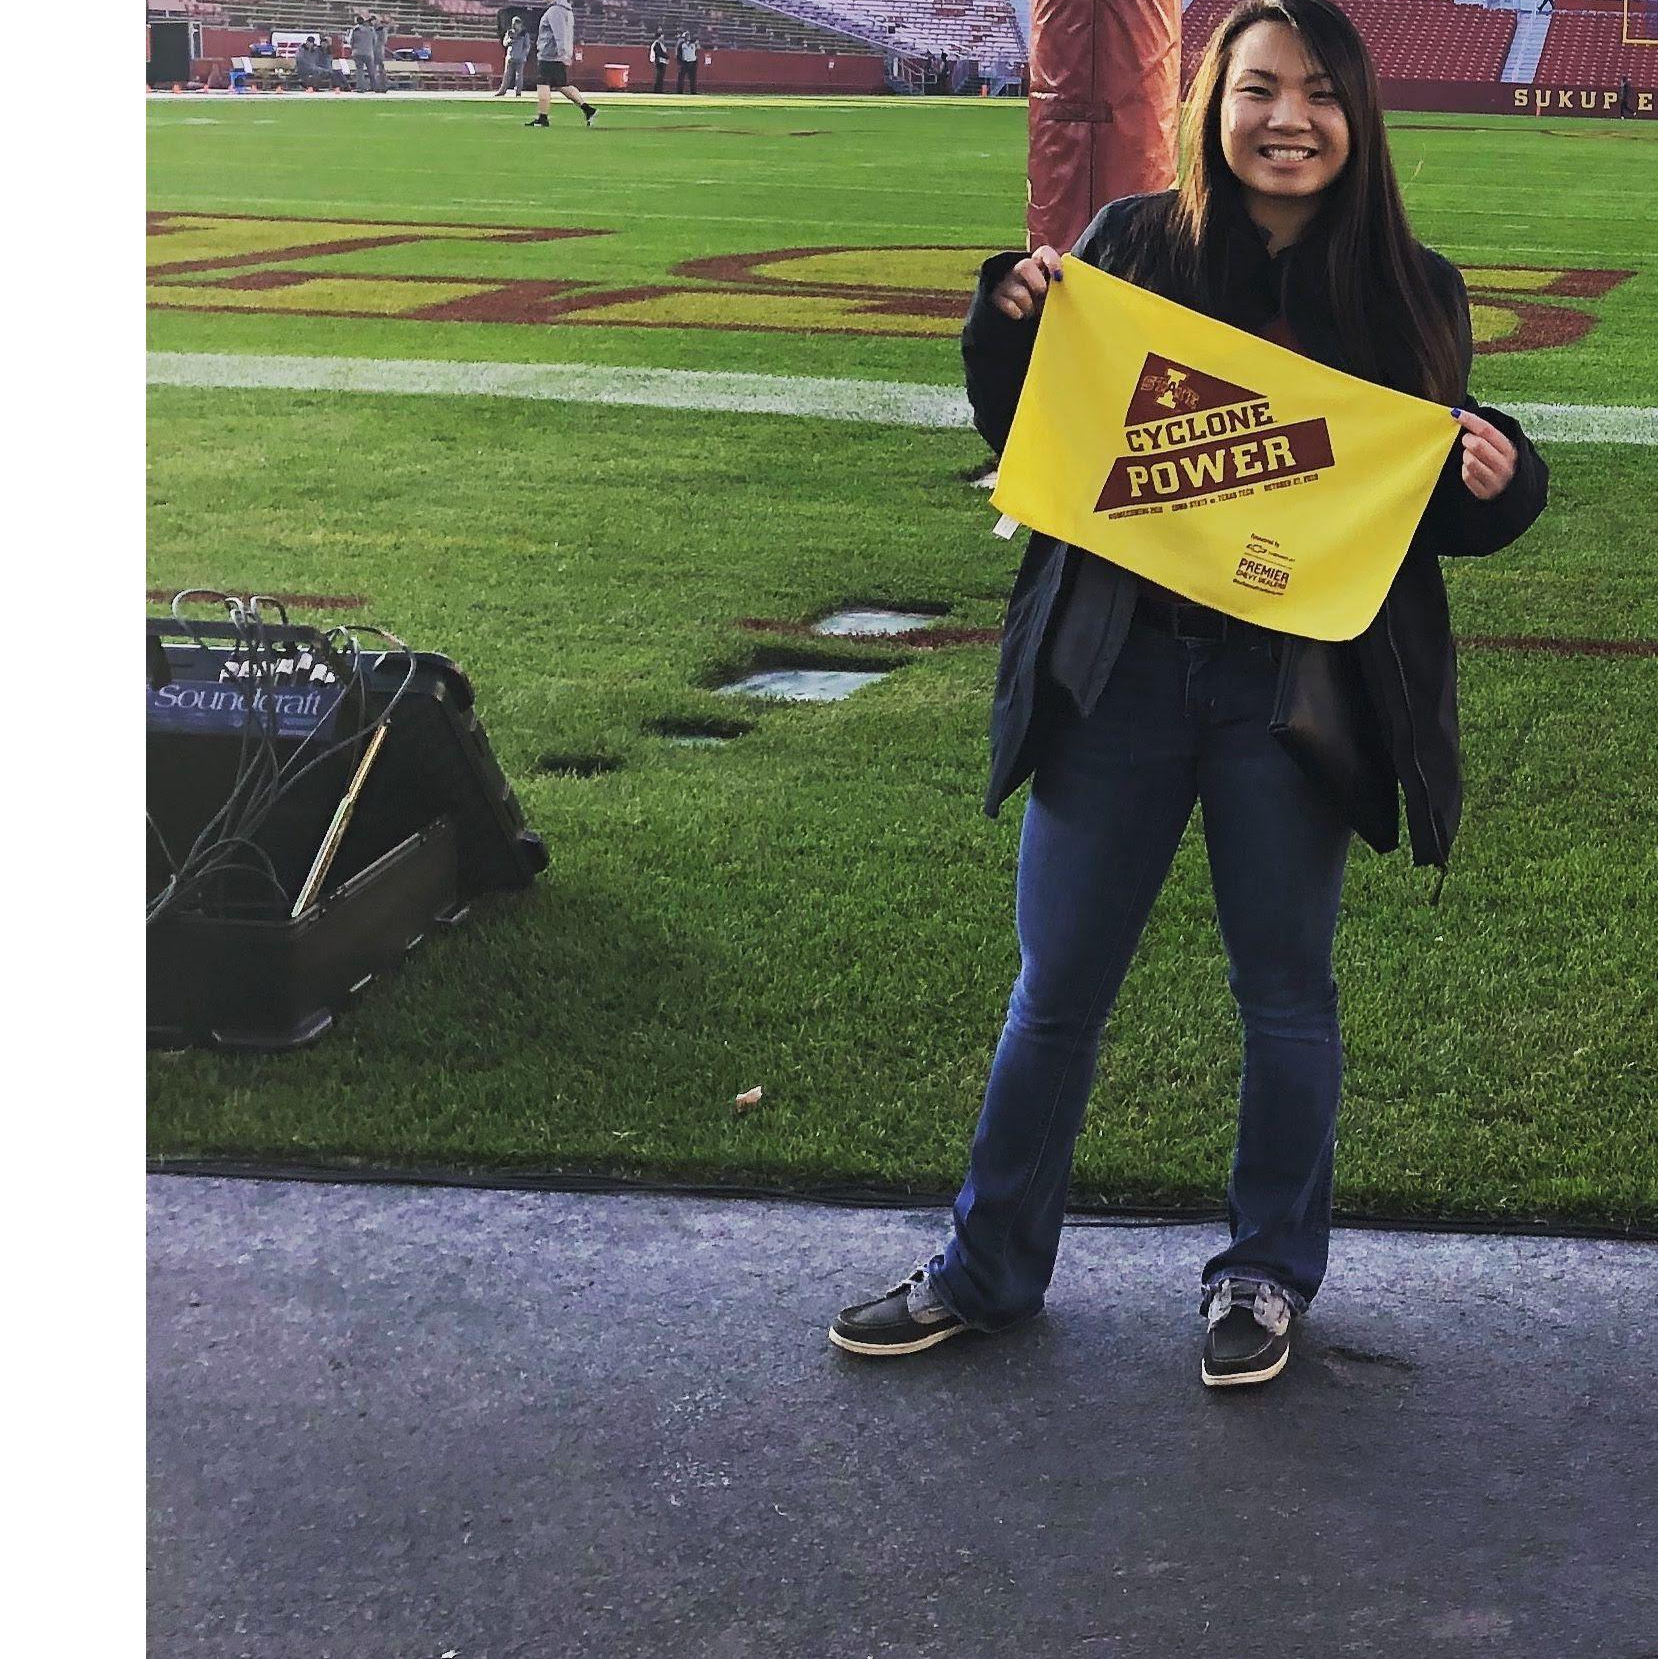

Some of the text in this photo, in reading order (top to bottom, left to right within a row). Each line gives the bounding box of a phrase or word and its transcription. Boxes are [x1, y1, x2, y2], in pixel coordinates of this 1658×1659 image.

[1514, 89, 1618, 109] SUKUP
[1125, 402, 1275, 452] CYCLONE
[1126, 435, 1297, 498] POWER
[1238, 558, 1290, 584] PREMIER
